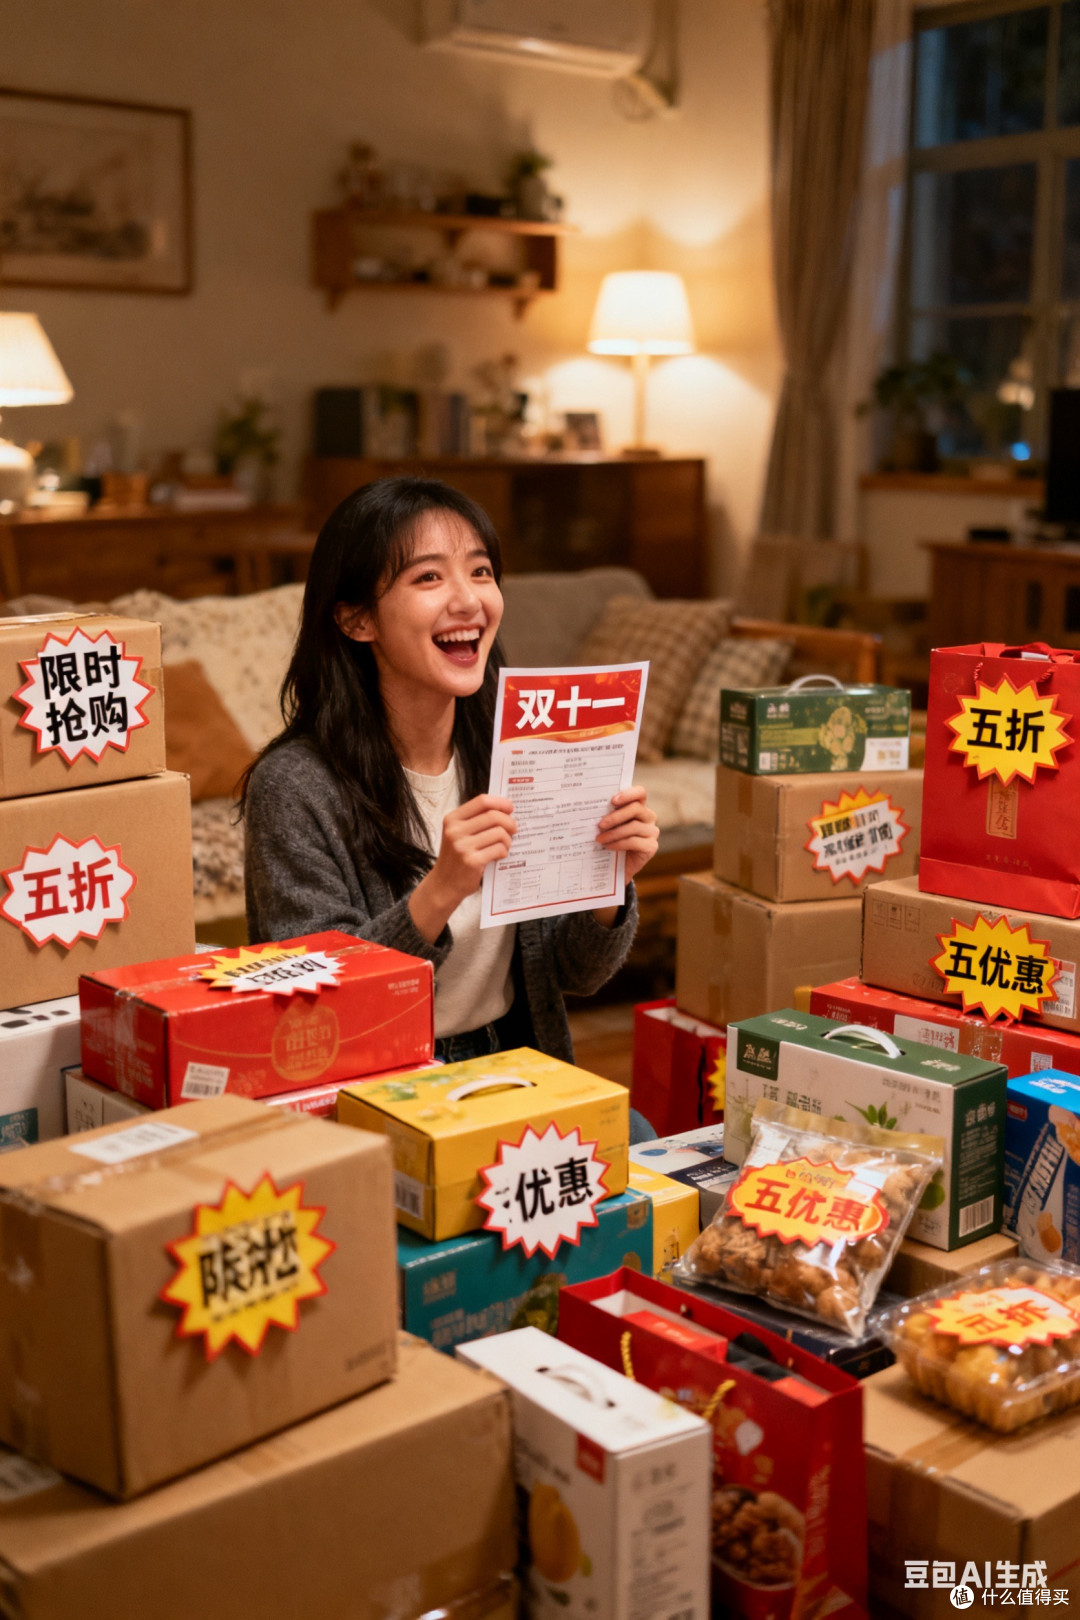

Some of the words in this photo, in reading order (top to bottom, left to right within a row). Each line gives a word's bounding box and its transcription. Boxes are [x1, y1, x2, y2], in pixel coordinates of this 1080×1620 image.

[40, 646, 121, 699] 限时
[46, 692, 129, 746] 抢购
[515, 685, 625, 729] 双十一
[967, 707, 1045, 753] 五折
[23, 857, 114, 922] 五折
[944, 940, 1048, 994] 五优惠
[744, 1177, 869, 1231] 五优惠
